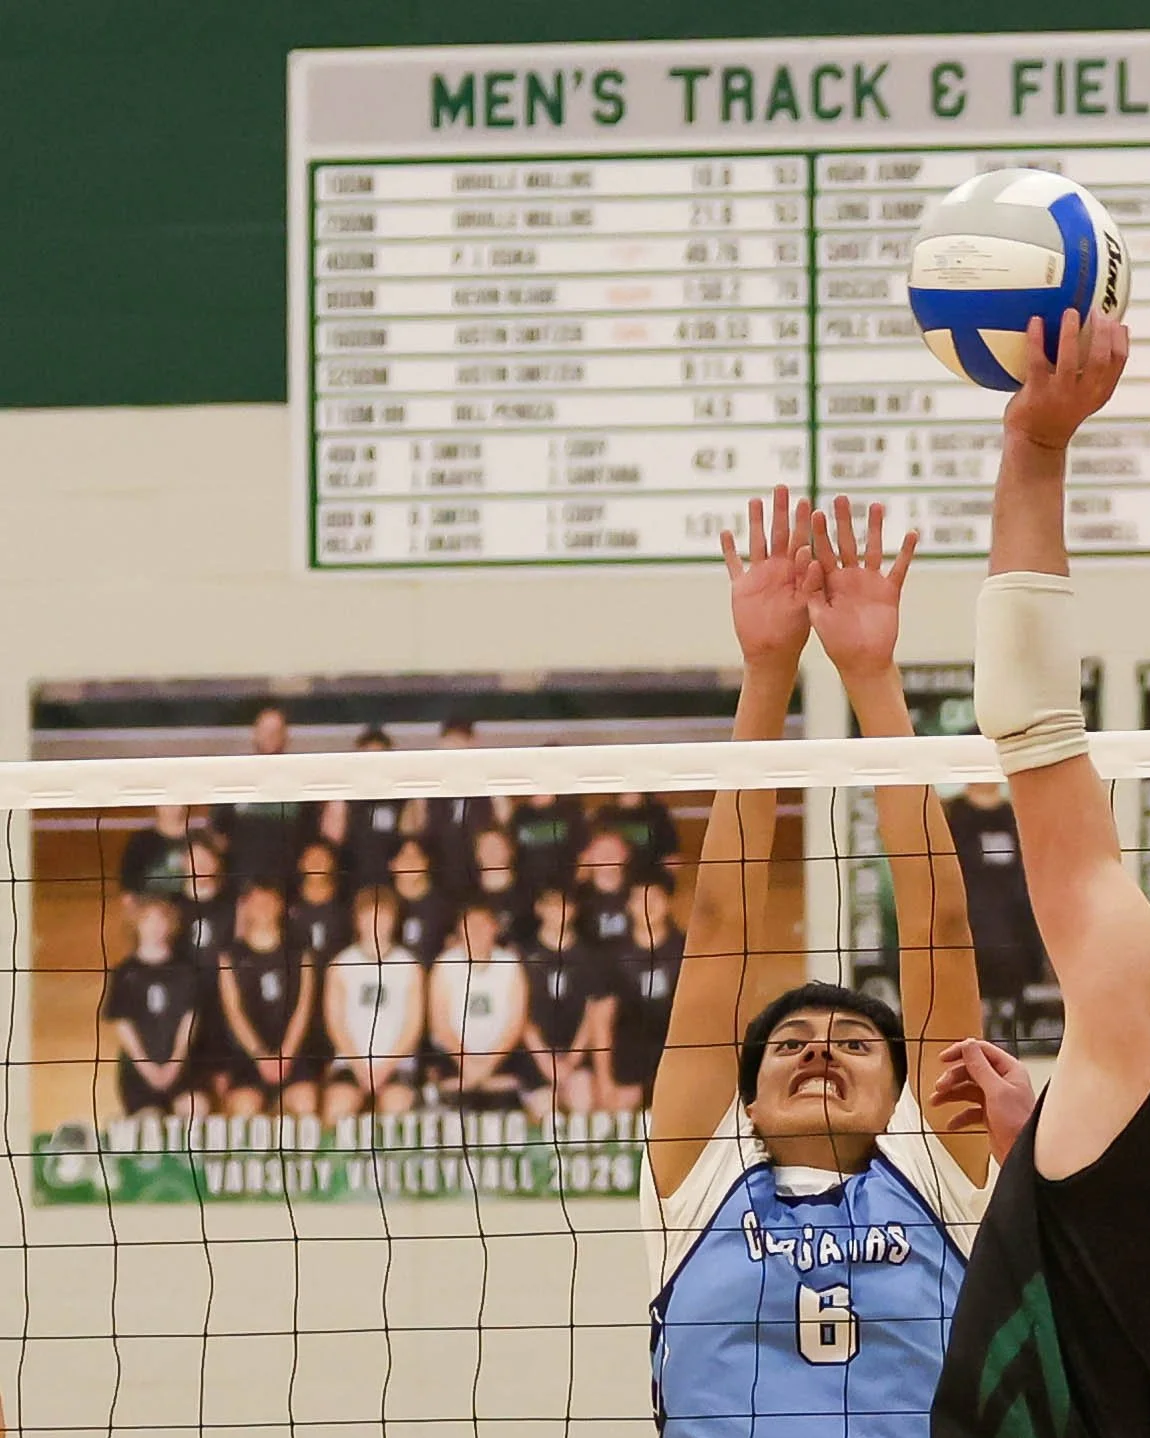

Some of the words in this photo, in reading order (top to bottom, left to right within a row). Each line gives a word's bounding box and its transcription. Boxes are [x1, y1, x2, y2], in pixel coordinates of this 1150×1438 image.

[430, 68, 627, 129] MEN'S
[667, 62, 890, 124] TRACK
[930, 61, 966, 119] &
[796, 1281, 860, 1366] 6
